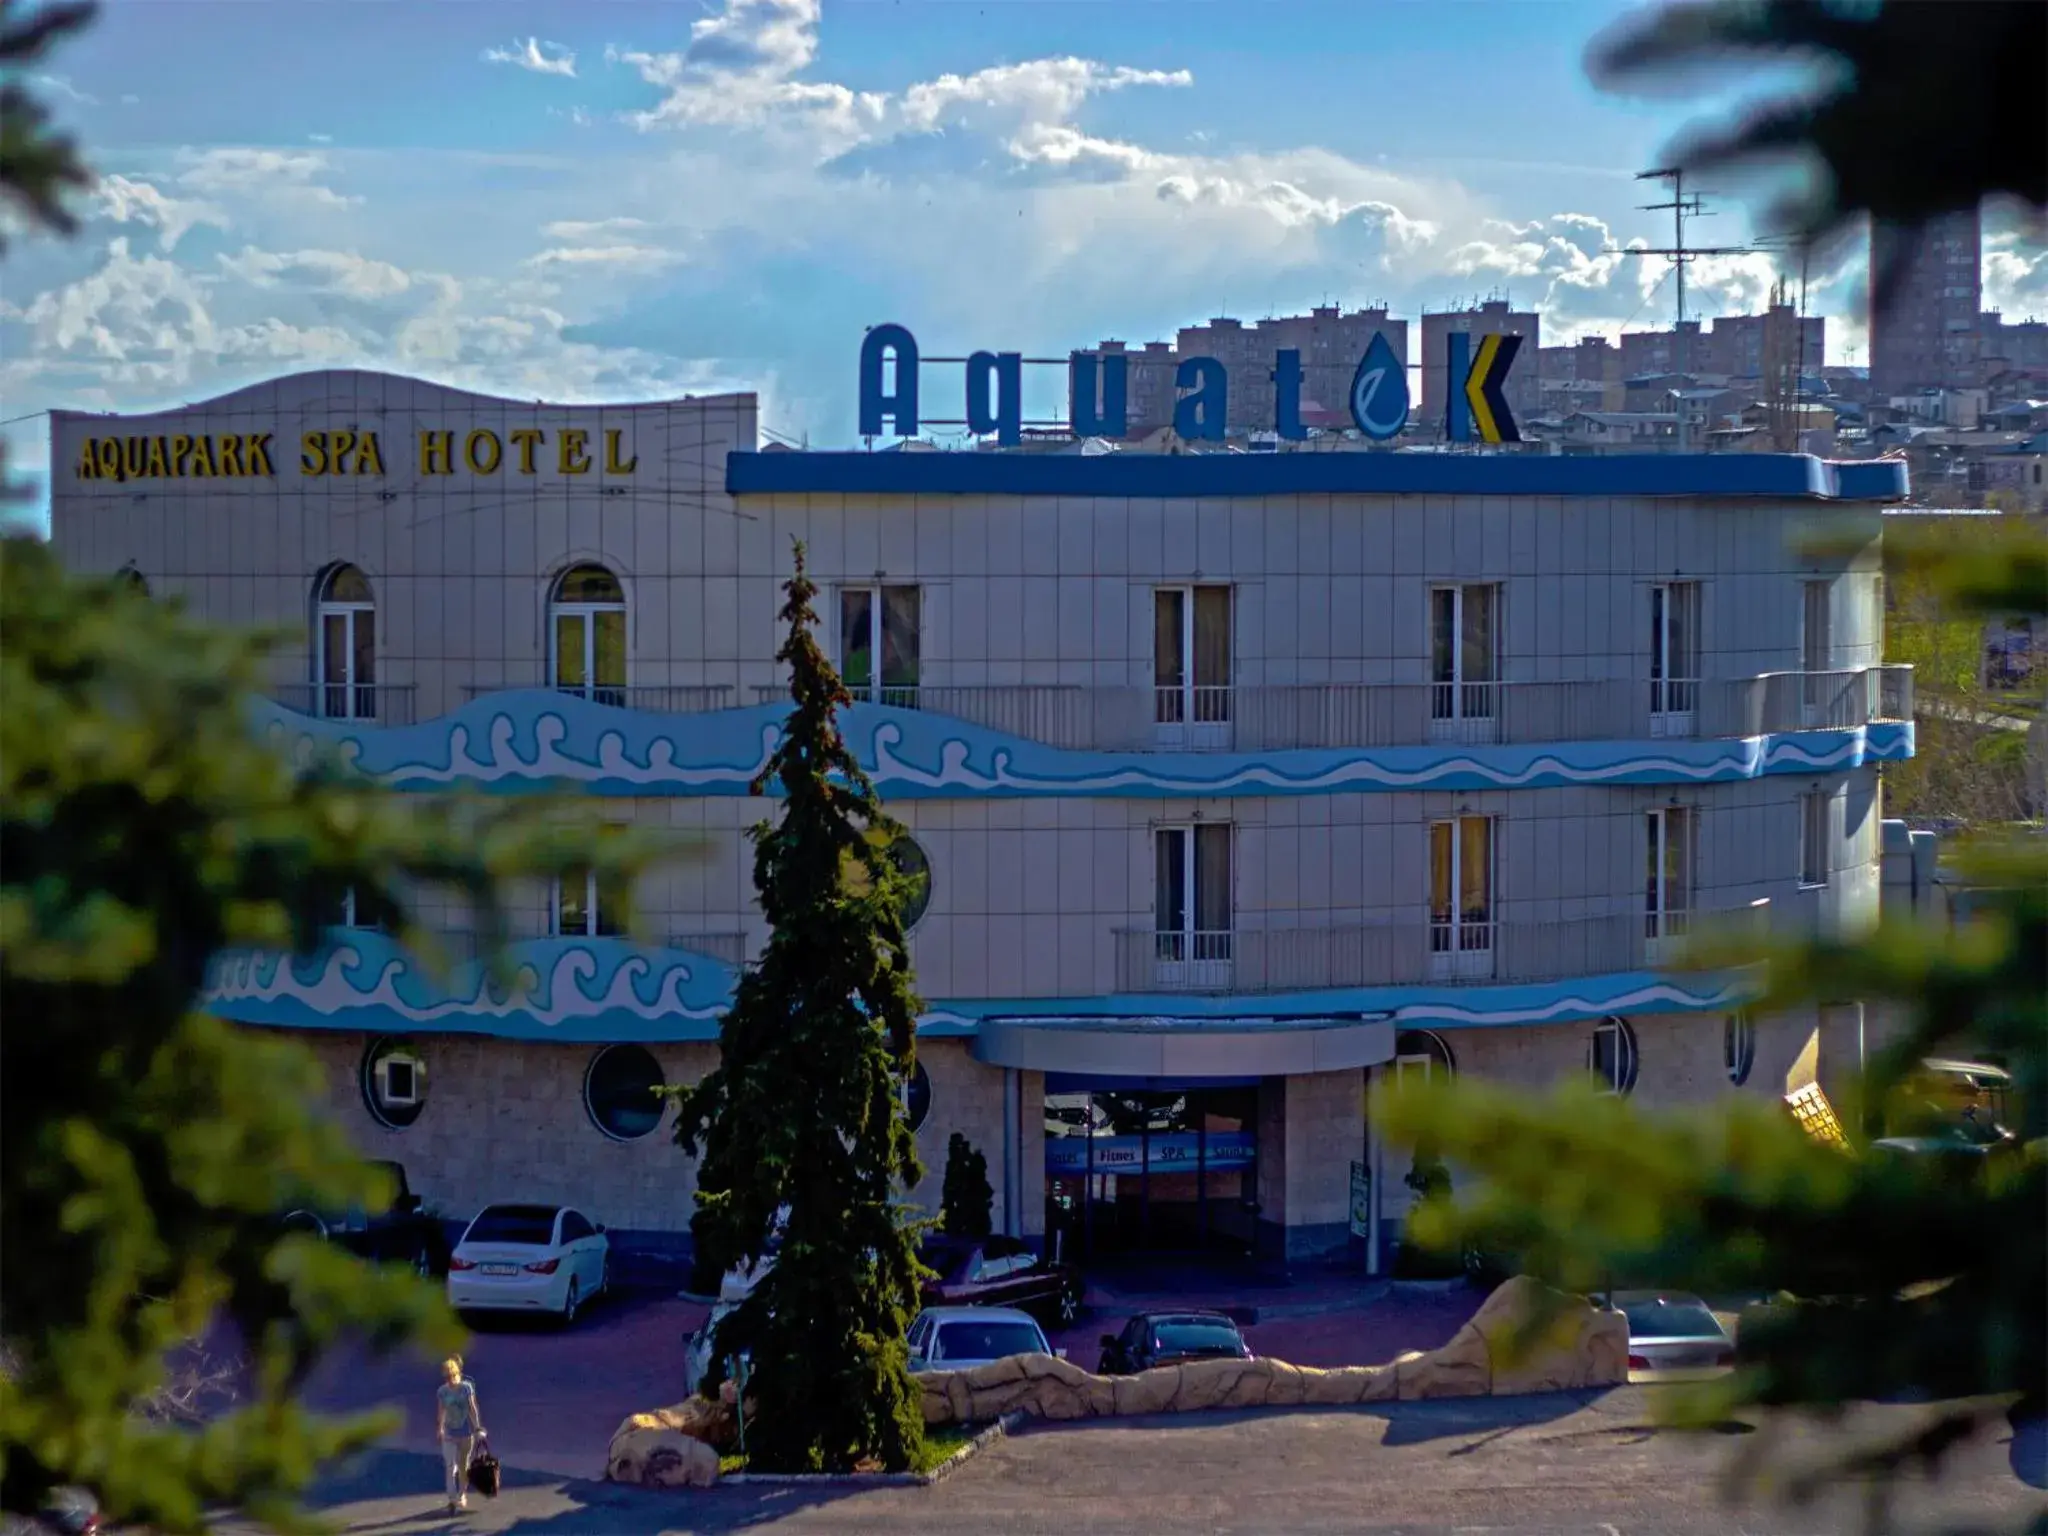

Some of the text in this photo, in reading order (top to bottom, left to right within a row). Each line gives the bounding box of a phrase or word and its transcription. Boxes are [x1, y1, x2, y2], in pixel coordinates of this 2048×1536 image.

[77, 428, 638, 482] AQUAPARK SPA HOTEL
[1161, 1145, 1187, 1160] SPA
